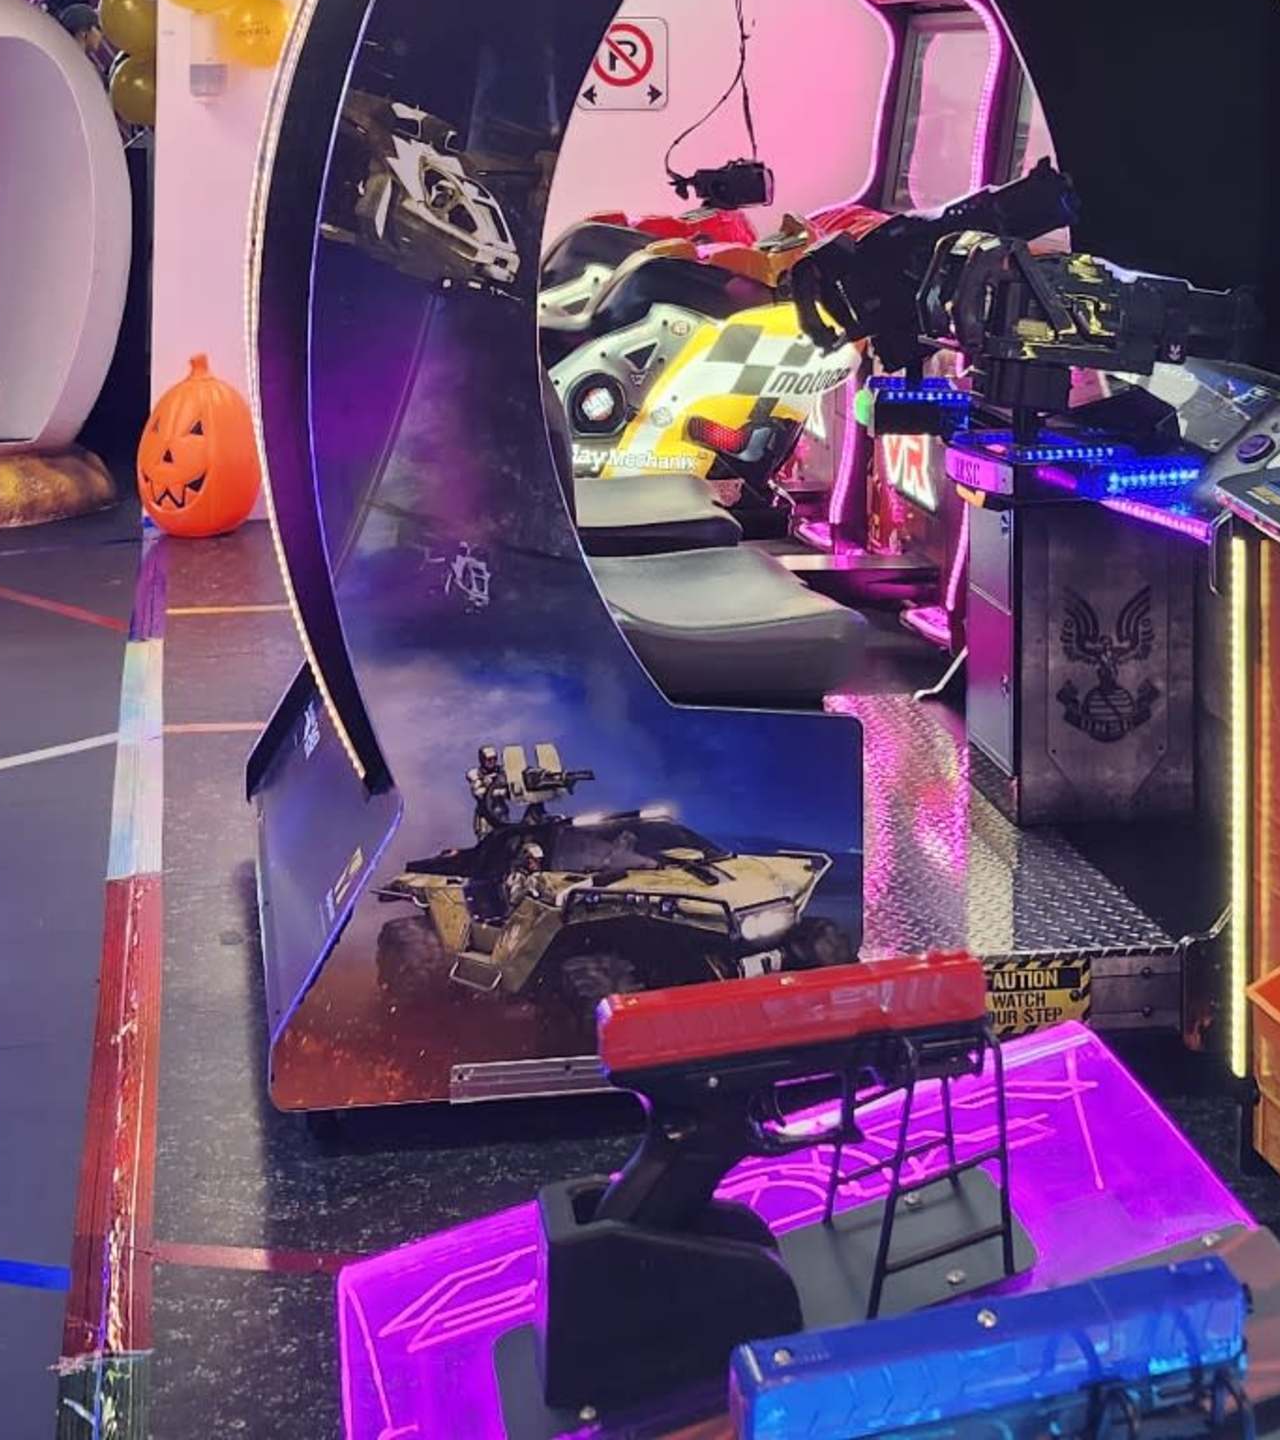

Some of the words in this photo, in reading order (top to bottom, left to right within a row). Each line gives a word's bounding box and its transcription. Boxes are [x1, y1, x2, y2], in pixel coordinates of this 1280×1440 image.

[608, 447, 696, 471] Mechanix
[992, 967, 1059, 990] AUTION
[991, 990, 1047, 1009] WATCH
[991, 1009, 1018, 1026] UR
[1022, 1005, 1064, 1024] STEP
